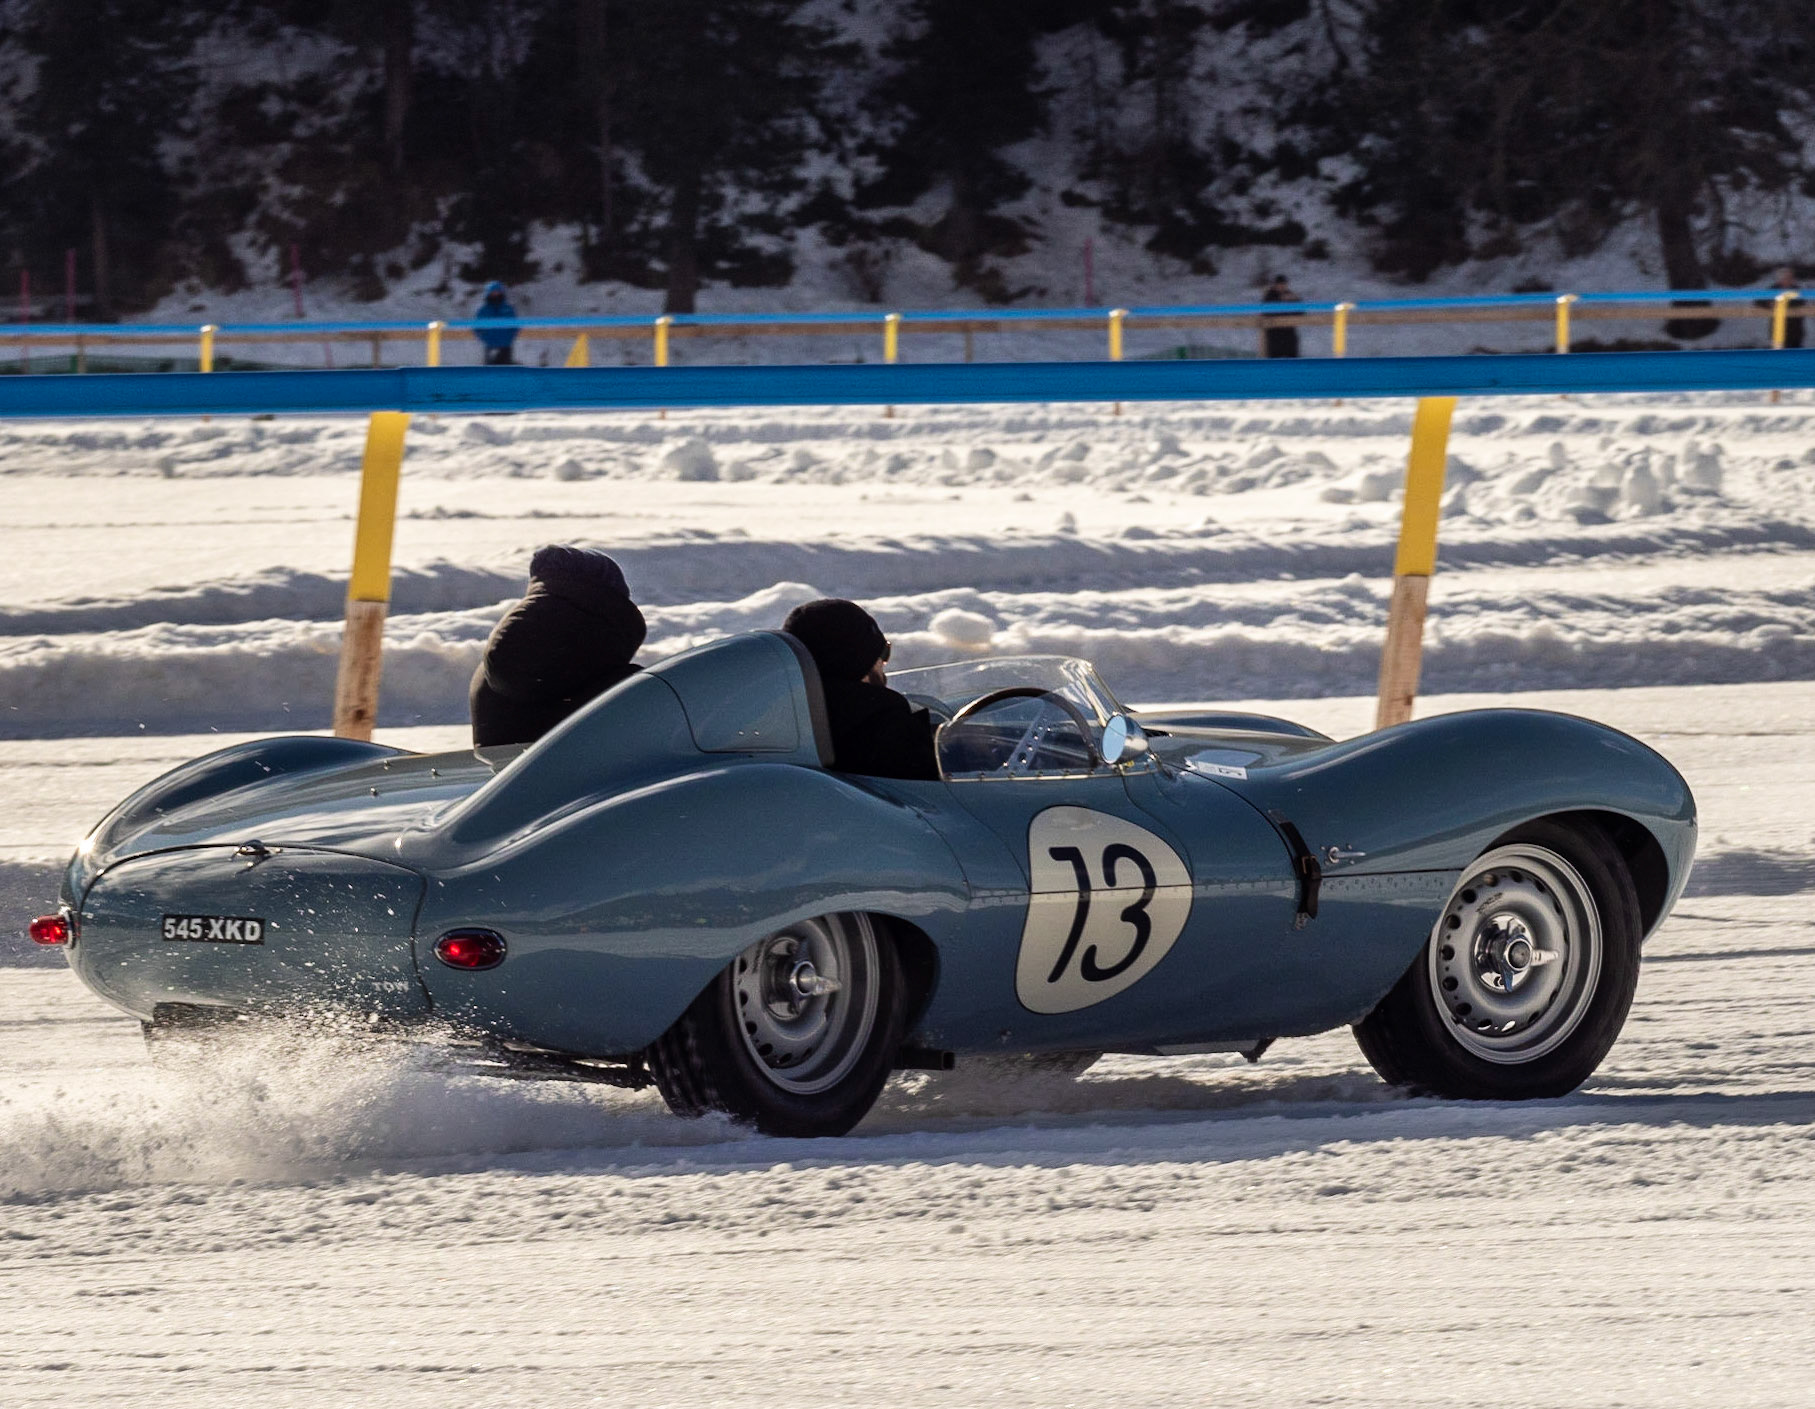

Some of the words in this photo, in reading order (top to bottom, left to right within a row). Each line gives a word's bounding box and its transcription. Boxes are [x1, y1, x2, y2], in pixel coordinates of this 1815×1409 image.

[1047, 843, 1157, 983] 13
[163, 917, 203, 939] 545
[207, 918, 262, 941] XKD
[371, 981, 408, 992] TOW
